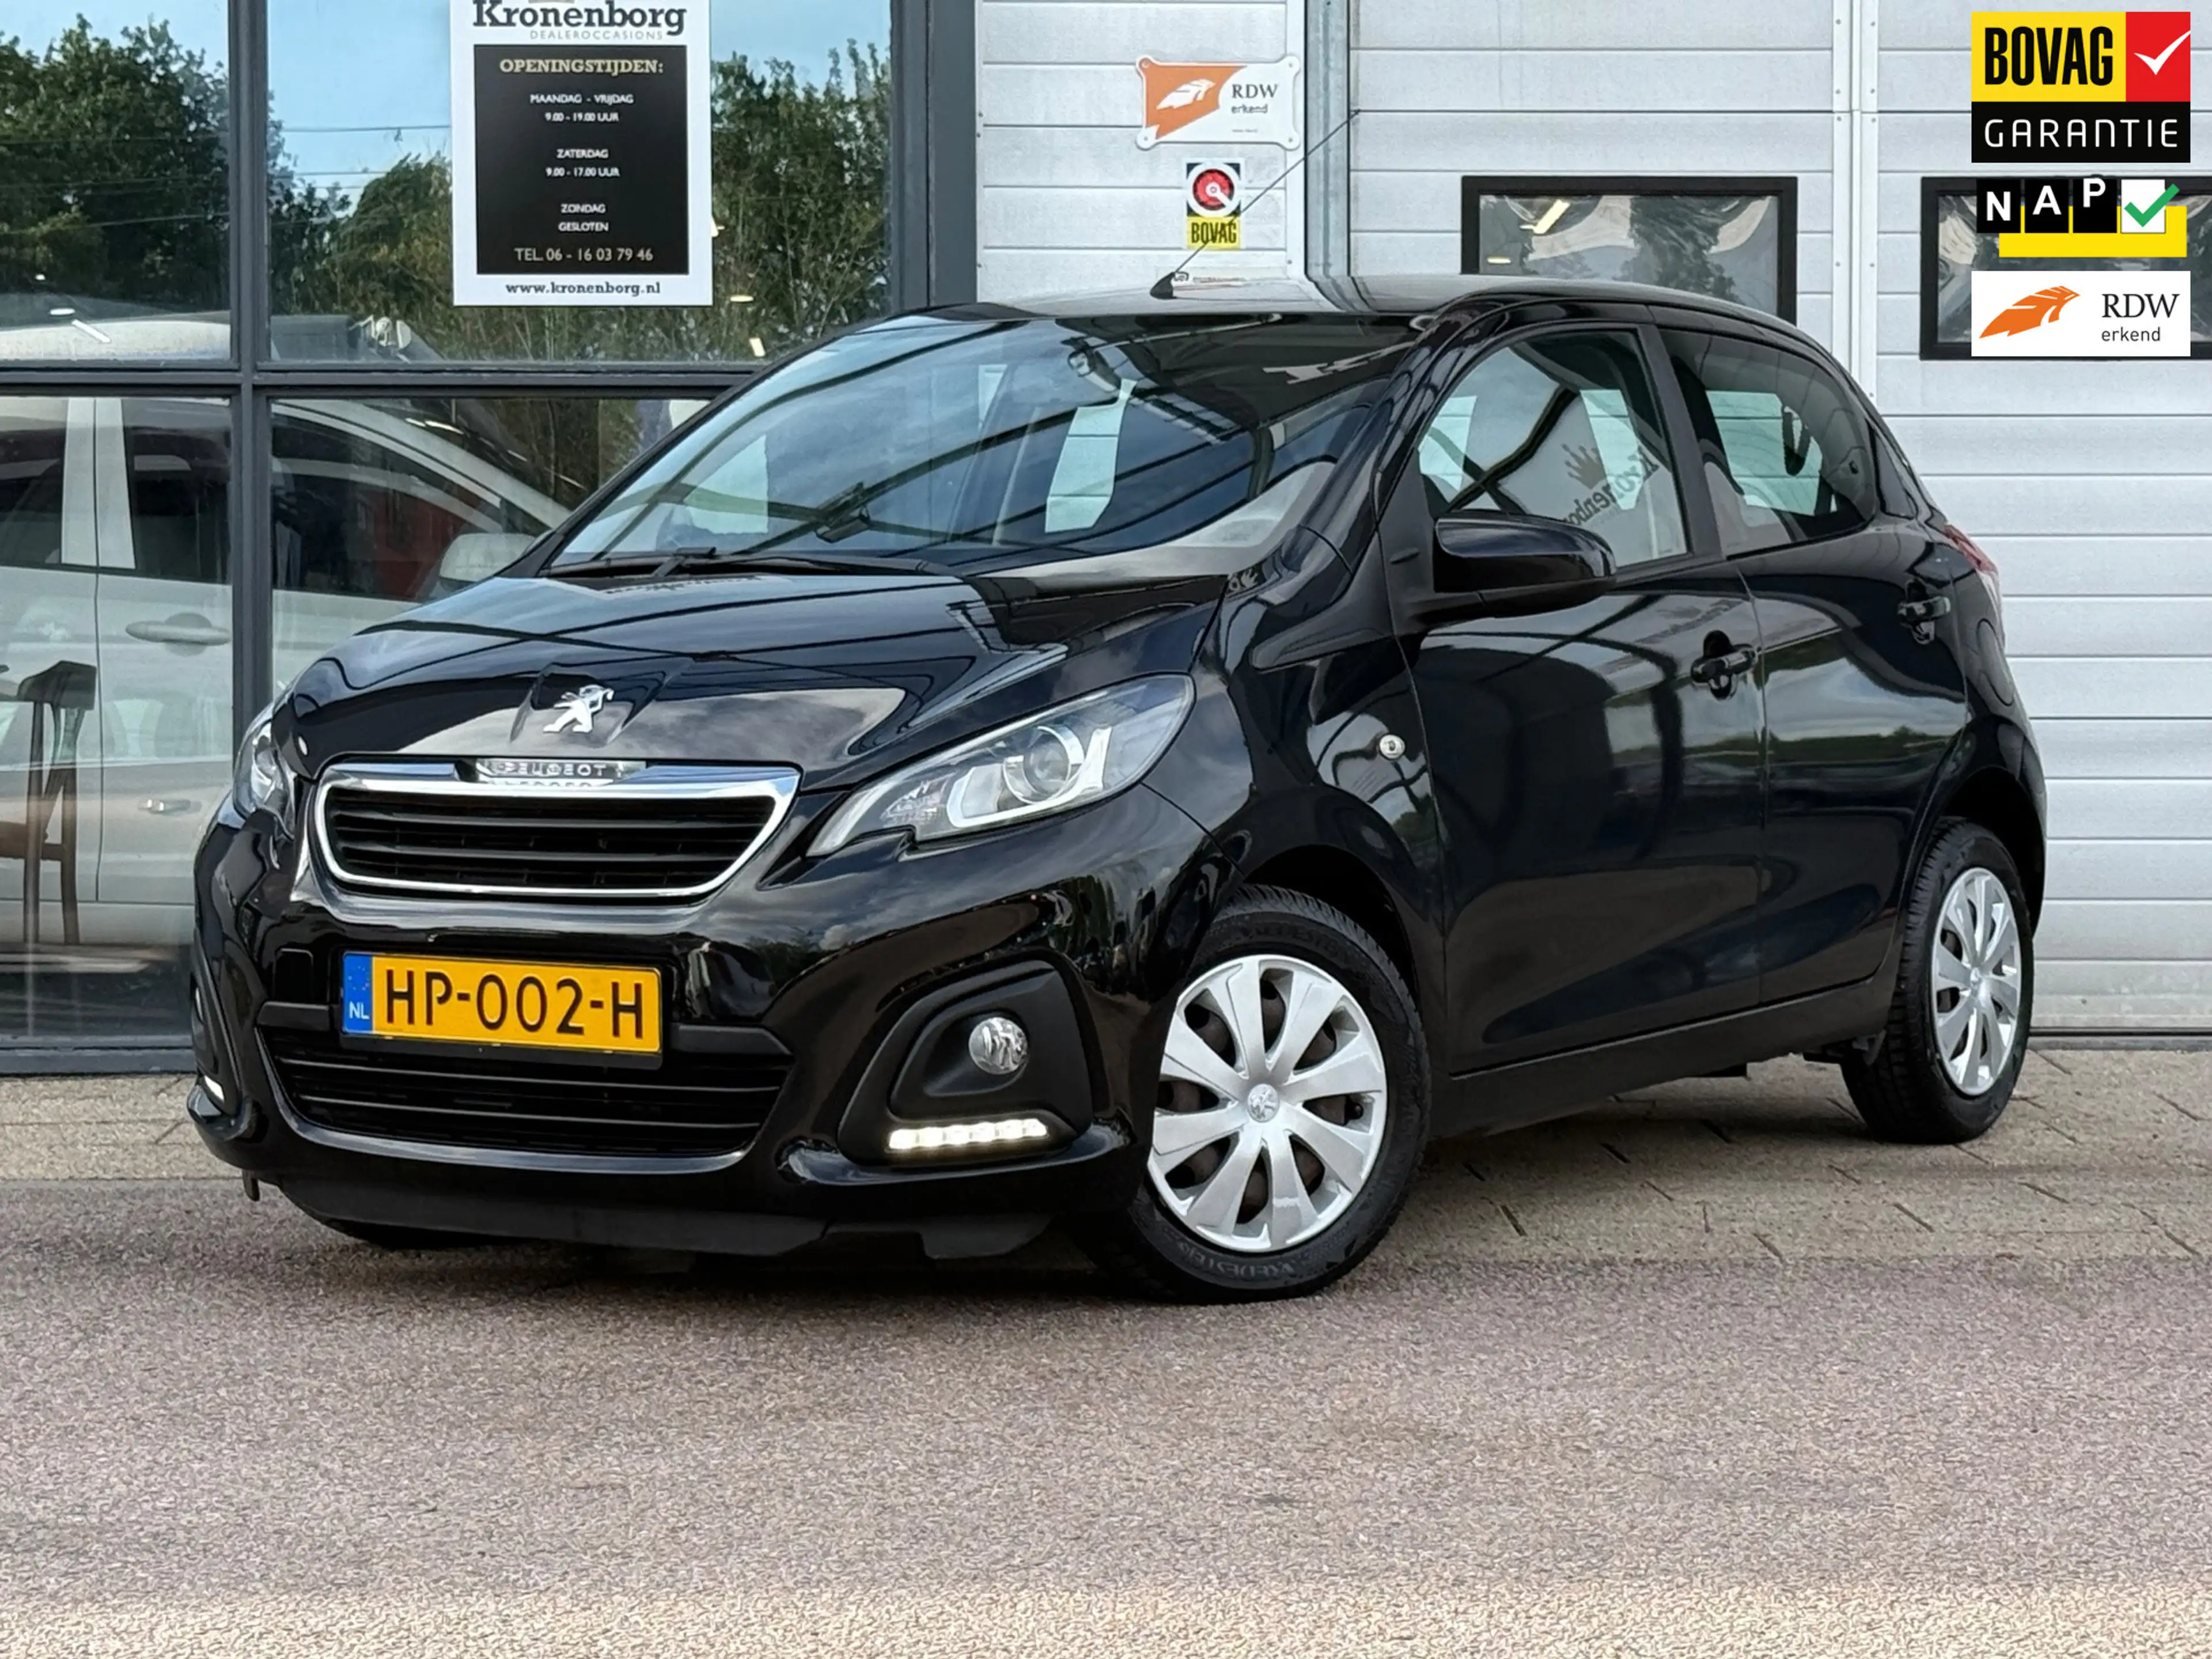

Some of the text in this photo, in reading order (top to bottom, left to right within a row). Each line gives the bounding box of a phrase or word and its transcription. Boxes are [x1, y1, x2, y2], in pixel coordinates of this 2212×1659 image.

[472, 0, 687, 36] Kronenborg
[530, 30, 662, 40] DEALEROCCASIONS
[499, 59, 663, 76] OPENINGSTIJDEN:
[1232, 84, 1278, 99] RDW
[530, 94, 582, 103] MAANDAG
[594, 94, 634, 105] VRIJDAG
[1231, 104, 1268, 114] erkend
[545, 112, 564, 122] 9.00
[573, 112, 595, 122] 19.00
[597, 112, 619, 122] UUR
[556, 149, 609, 158] ZATERDAG
[546, 167, 565, 177] 9.00
[574, 167, 596, 177] 17.00
[598, 167, 620, 177] UUR
[560, 203, 606, 214] ZONDAG
[558, 222, 609, 232] GESLOTEN
[1191, 221, 1237, 244] BOVAG
[546, 248, 563, 262] 06
[578, 248, 592, 262] 16
[596, 248, 612, 262] 03
[617, 248, 633, 262] 79
[637, 248, 653, 262] 46
[506, 281, 660, 297] www.kronenborg.nl
[386, 969, 642, 1039] HP-002-H
[349, 1001, 369, 1020] NL
